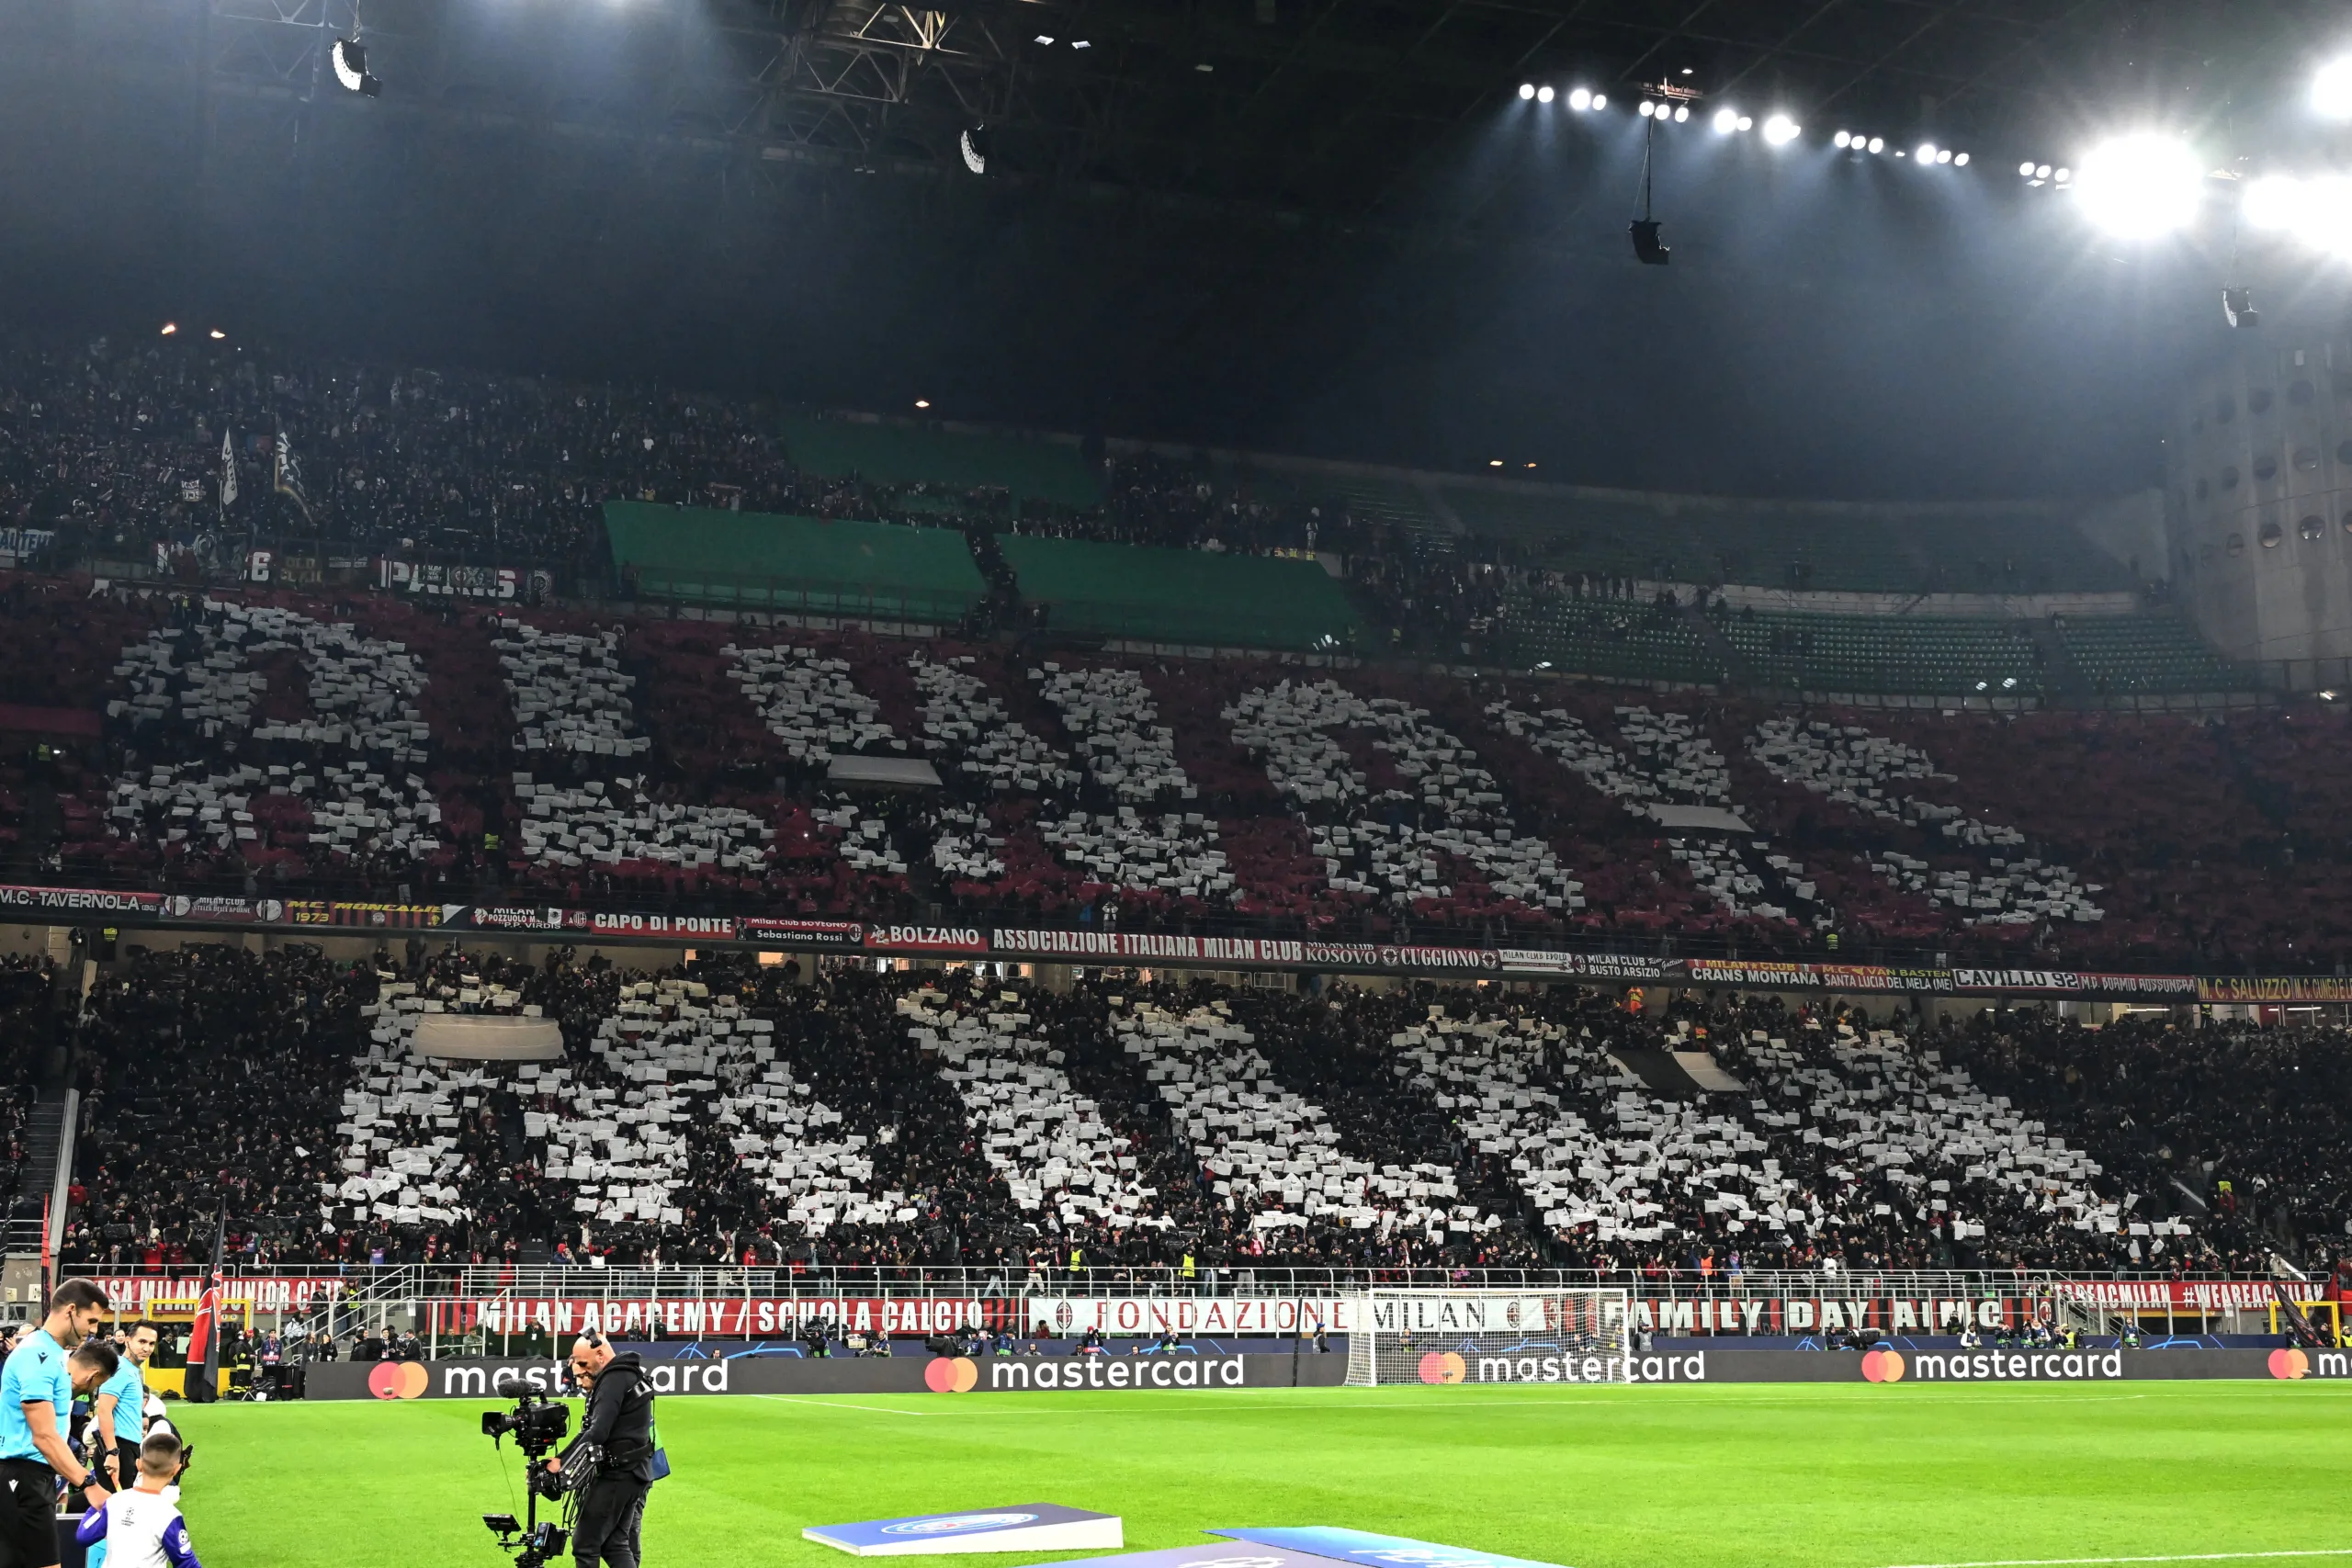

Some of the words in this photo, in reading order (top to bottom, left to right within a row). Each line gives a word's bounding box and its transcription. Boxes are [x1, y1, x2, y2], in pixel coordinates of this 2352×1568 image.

[39, 892, 140, 910] TAVERNOLA
[226, 897, 245, 907] CLUB
[295, 912, 329, 922] 1973
[488, 913, 526, 923] POZZUOLO
[493, 907, 535, 915] MILAN
[595, 913, 643, 930] CAPO
[650, 916, 668, 931] DI
[674, 917, 732, 933] PONTE
[756, 930, 814, 942] Sebastiano
[816, 931, 843, 942] Rossi
[889, 925, 980, 945] BOLZANO
[993, 928, 1118, 954] ASSOCIAZIONE
[1123, 933, 1199, 957] ITALIANA
[1203, 937, 1256, 960] MILAN
[1260, 939, 1302, 962] CLUB
[1306, 948, 1377, 964] KOSOVO
[1400, 948, 1479, 967] CUGGIONO
[1503, 951, 1524, 959] MILAN
[1526, 952, 1544, 960] CLUB
[1588, 955, 1618, 965] MILAN
[1621, 956, 1645, 966] CLUB
[1589, 964, 1621, 975] BUSTO
[1623, 966, 1660, 978] ARSIZIO
[1705, 960, 1748, 969] MILAN
[1759, 962, 1796, 971] CLUB
[1866, 967, 1896, 976] VAN
[1899, 969, 1951, 978] BASTEN
[1691, 967, 1744, 982] CRANS
[1747, 969, 1820, 985] MONTANA
[1824, 975, 1856, 987] SANTA
[1858, 976, 1885, 988] LUCIA
[1886, 976, 1905, 989] DEL
[1906, 977, 1930, 989] MELA
[1932, 977, 1953, 992] (ME)
[2052, 973, 2079, 989] 92
[2102, 977, 2138, 991] BORMIO
[2139, 978, 2195, 993] ROSSONERA
[2231, 977, 2290, 1000] SALUZZO
[140, 1280, 199, 1311] MILAN
[477, 1301, 572, 1332] MILAN
[582, 1301, 726, 1333] ACADEMY
[735, 1301, 748, 1332] /
[758, 1301, 872, 1332] SCUOLA
[881, 1301, 983, 1332] CALCIO
[1096, 1301, 1349, 1329] FONDAZIONE
[1373, 1302, 1486, 1328] MILAN
[1604, 1301, 1764, 1329] FAMILY
[1788, 1301, 1870, 1328] DAY
[992, 1354, 1244, 1389] mastercard
[1478, 1350, 1705, 1382] mastercard
[1916, 1349, 2121, 1379] mastercard
[445, 1359, 729, 1394] mastard
